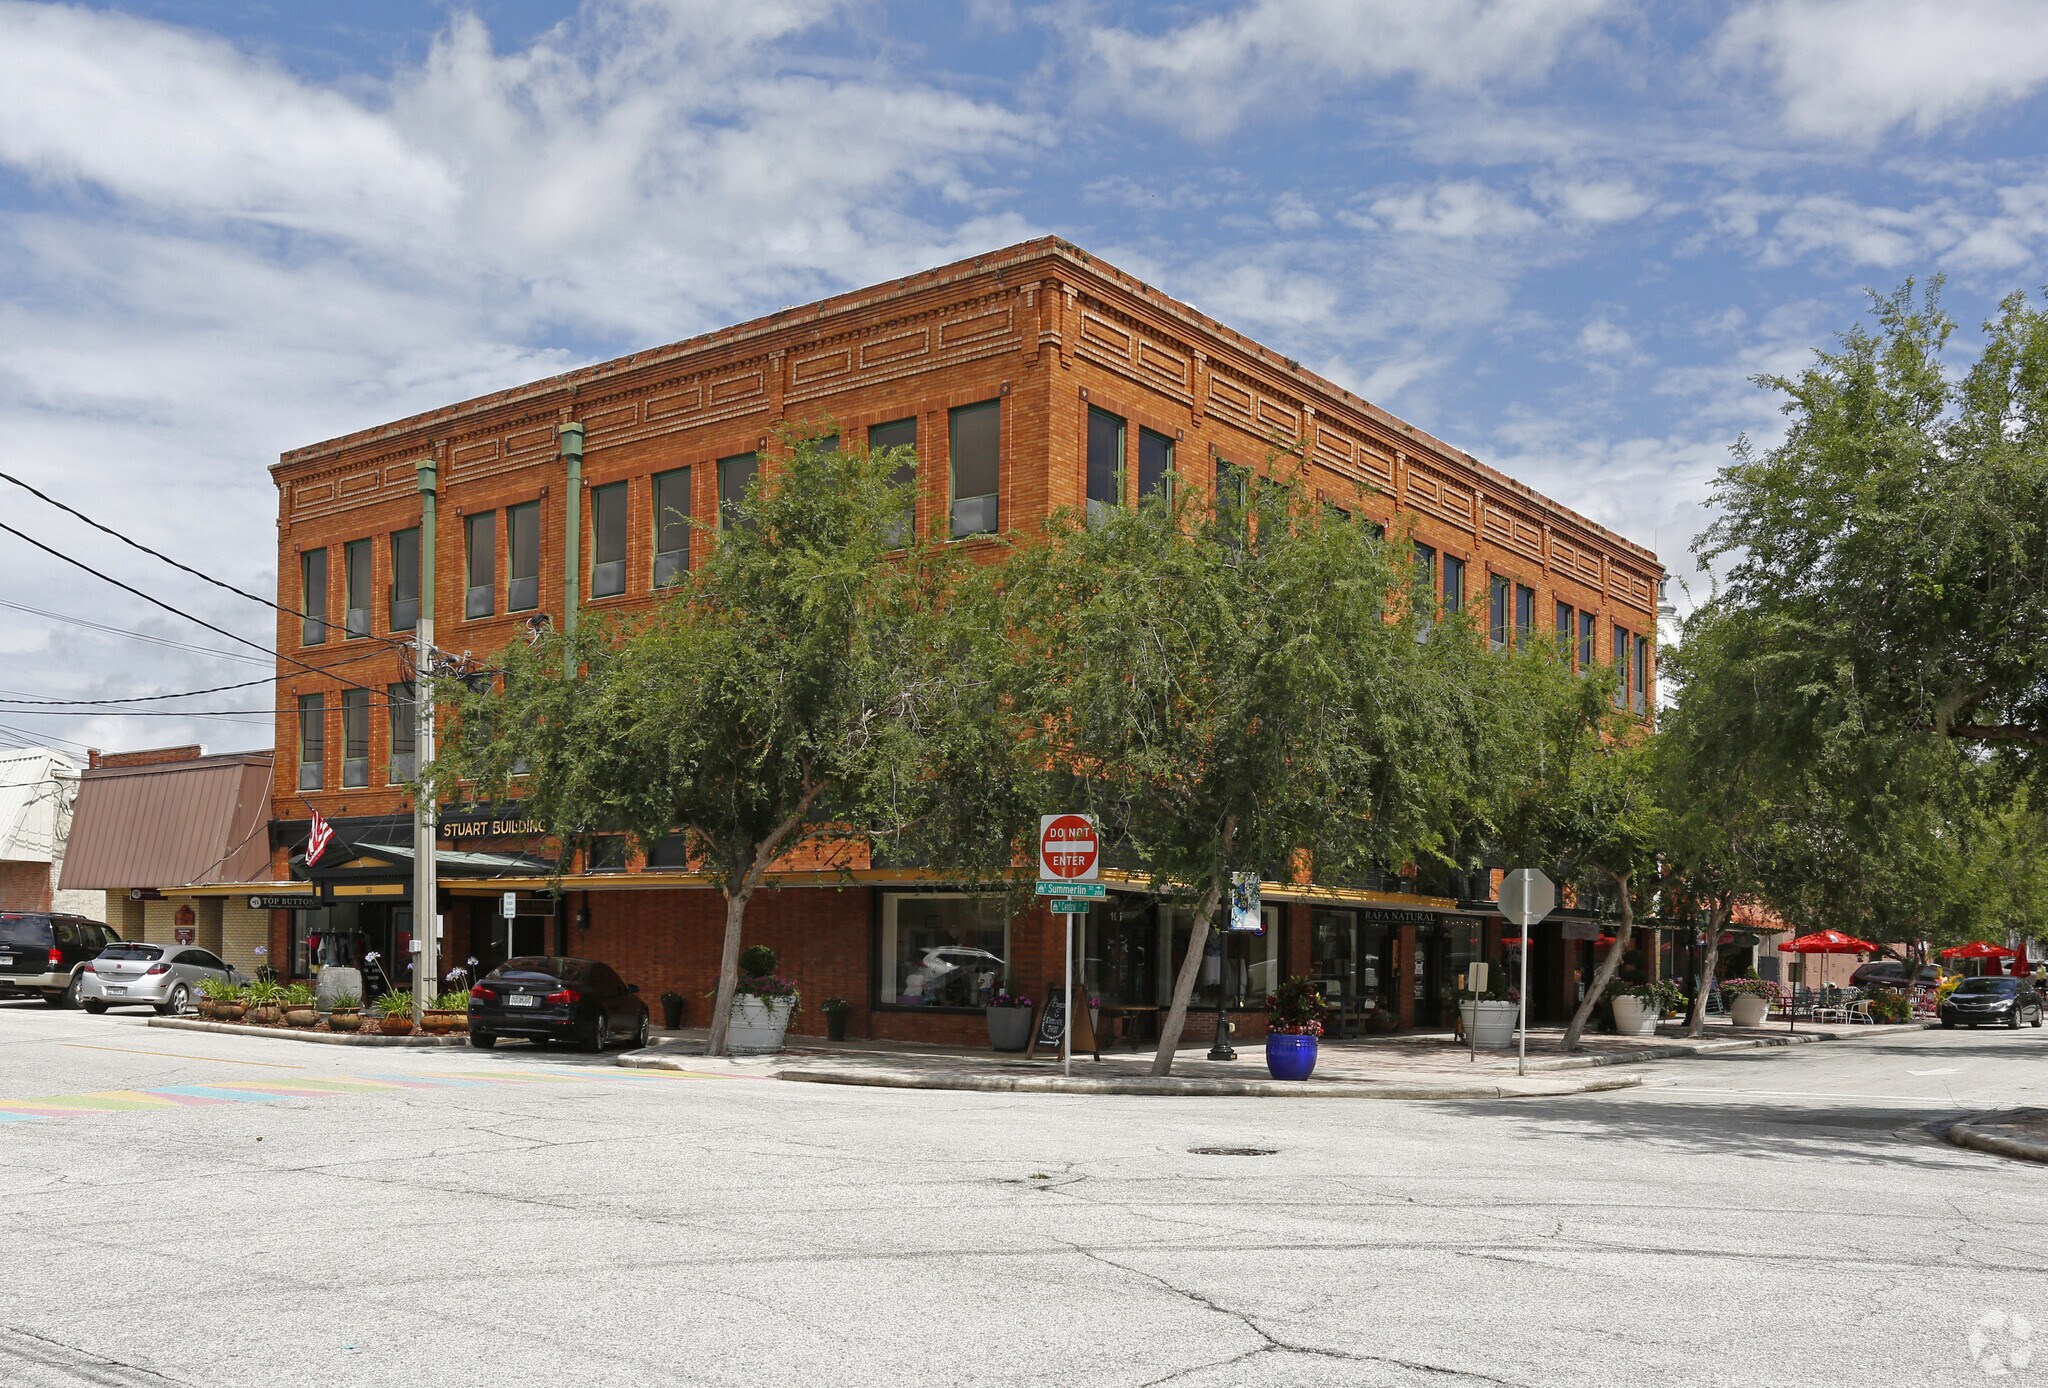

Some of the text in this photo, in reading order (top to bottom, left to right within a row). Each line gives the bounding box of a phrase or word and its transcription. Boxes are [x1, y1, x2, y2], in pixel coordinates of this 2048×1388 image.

[444, 819, 547, 837] STUART BUILDING
[1050, 827, 1090, 838] DO NOT
[1053, 856, 1085, 866] ENTER
[1048, 883, 1087, 895] Summerlin
[262, 897, 280, 905] TOP
[1365, 911, 1436, 922] RAFA NATURAL
